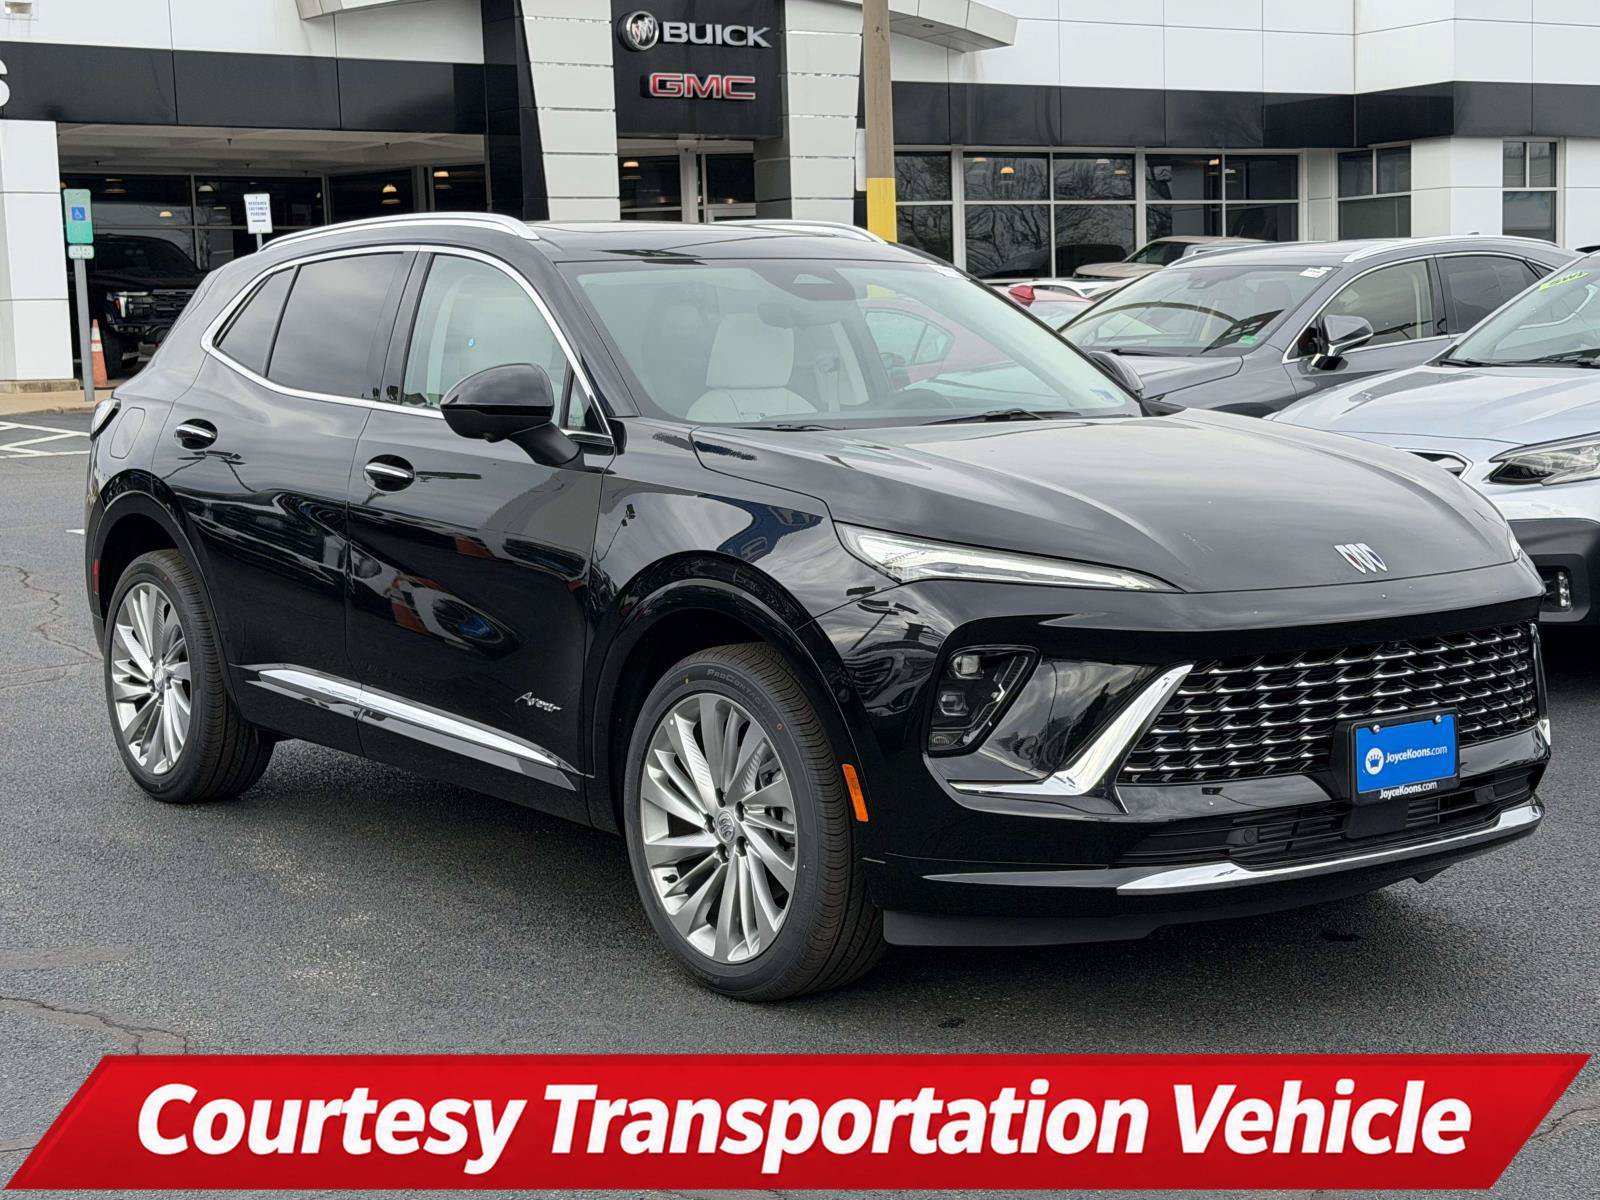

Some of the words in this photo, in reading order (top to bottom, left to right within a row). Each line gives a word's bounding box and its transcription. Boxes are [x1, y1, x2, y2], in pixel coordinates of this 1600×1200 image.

[662, 21, 772, 48] BUICK
[649, 72, 756, 100] GMC
[1385, 745, 1448, 764] JoyceKoons.com
[1379, 781, 1438, 799] JoyceKoons.com
